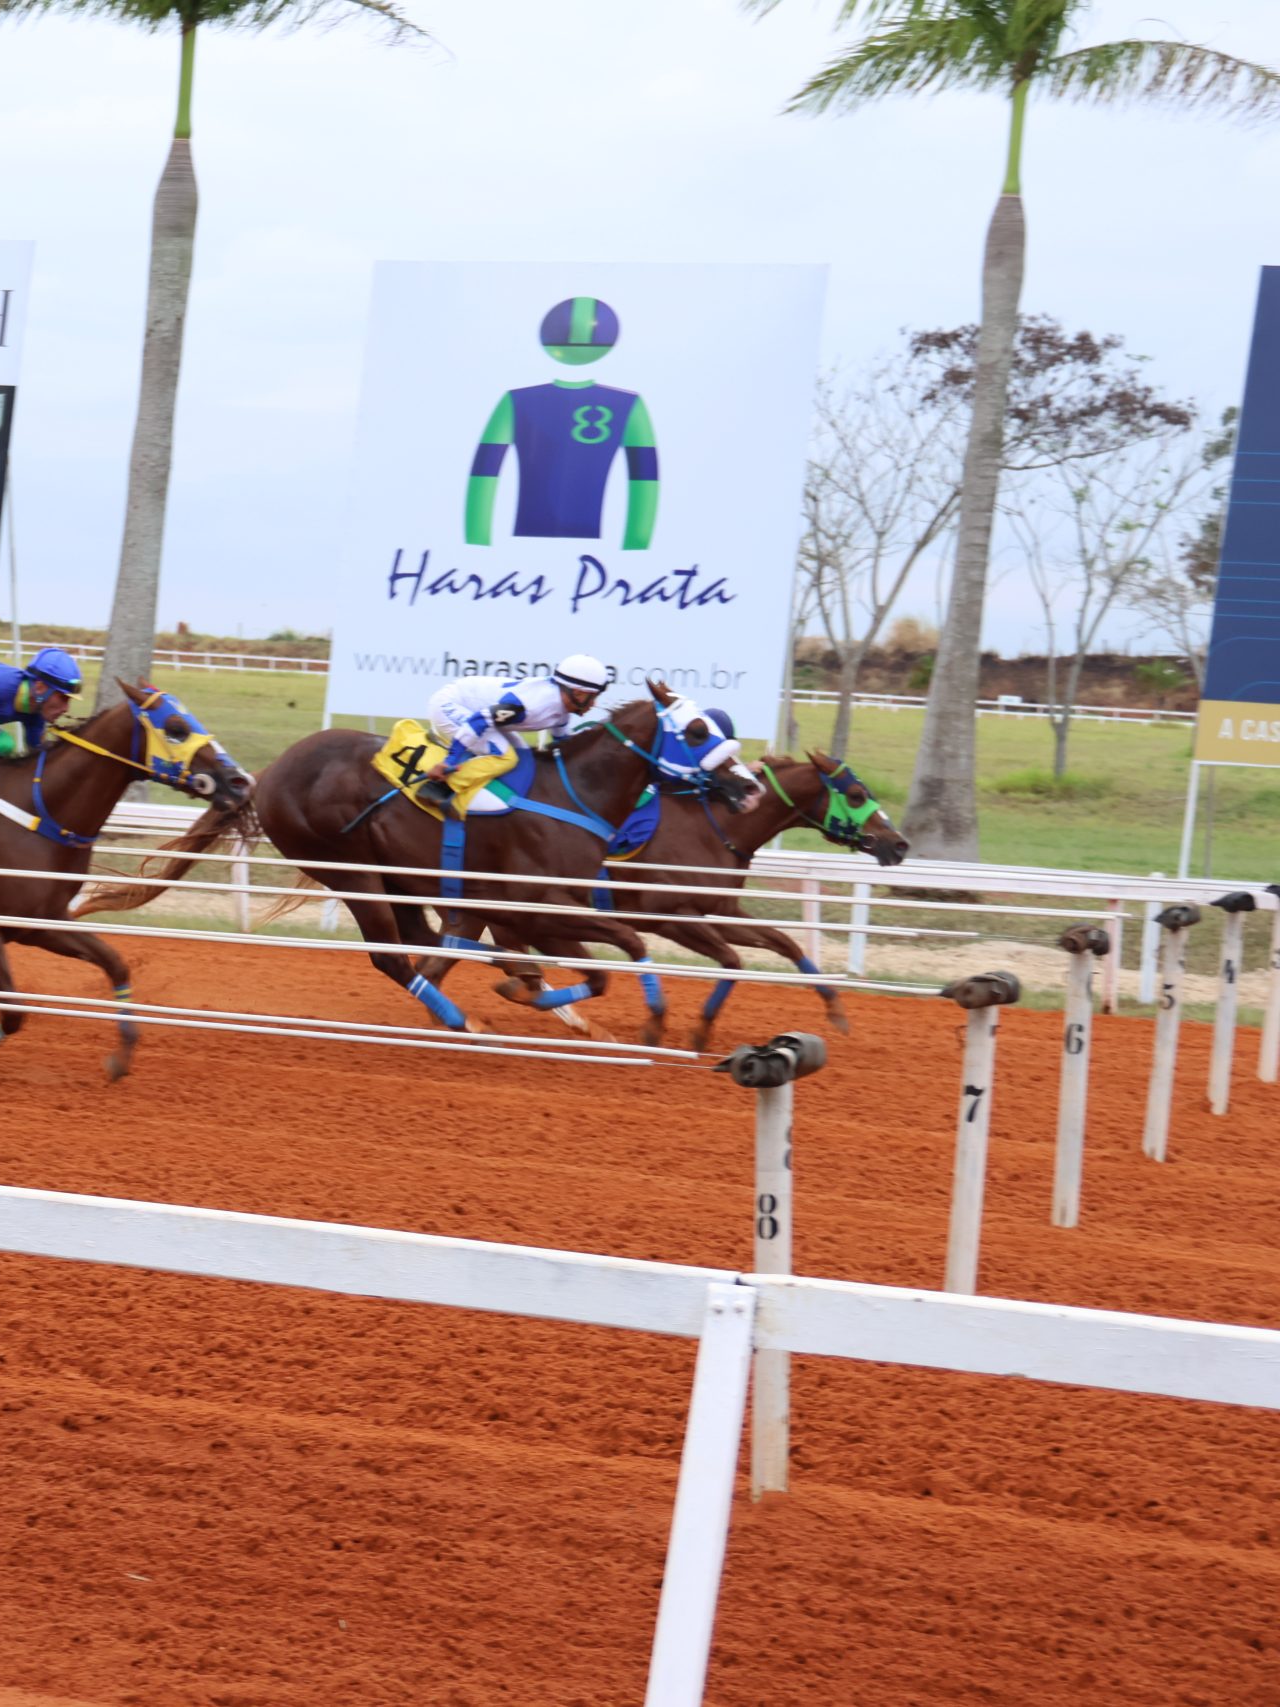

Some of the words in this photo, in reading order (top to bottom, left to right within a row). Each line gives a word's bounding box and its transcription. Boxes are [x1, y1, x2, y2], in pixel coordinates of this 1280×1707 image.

[571, 405, 613, 444] 8
[387, 548, 553, 606] Haras
[570, 554, 738, 614] Prata
[353, 651, 748, 690] www.haraspa.com.br
[495, 709, 516, 722] 4
[1217, 718, 1234, 739] A
[391, 745, 428, 787] 4
[1160, 984, 1175, 1010] 5
[1065, 1024, 1084, 1055] 6
[963, 1085, 984, 1123] 7
[757, 1193, 778, 1240] 8
